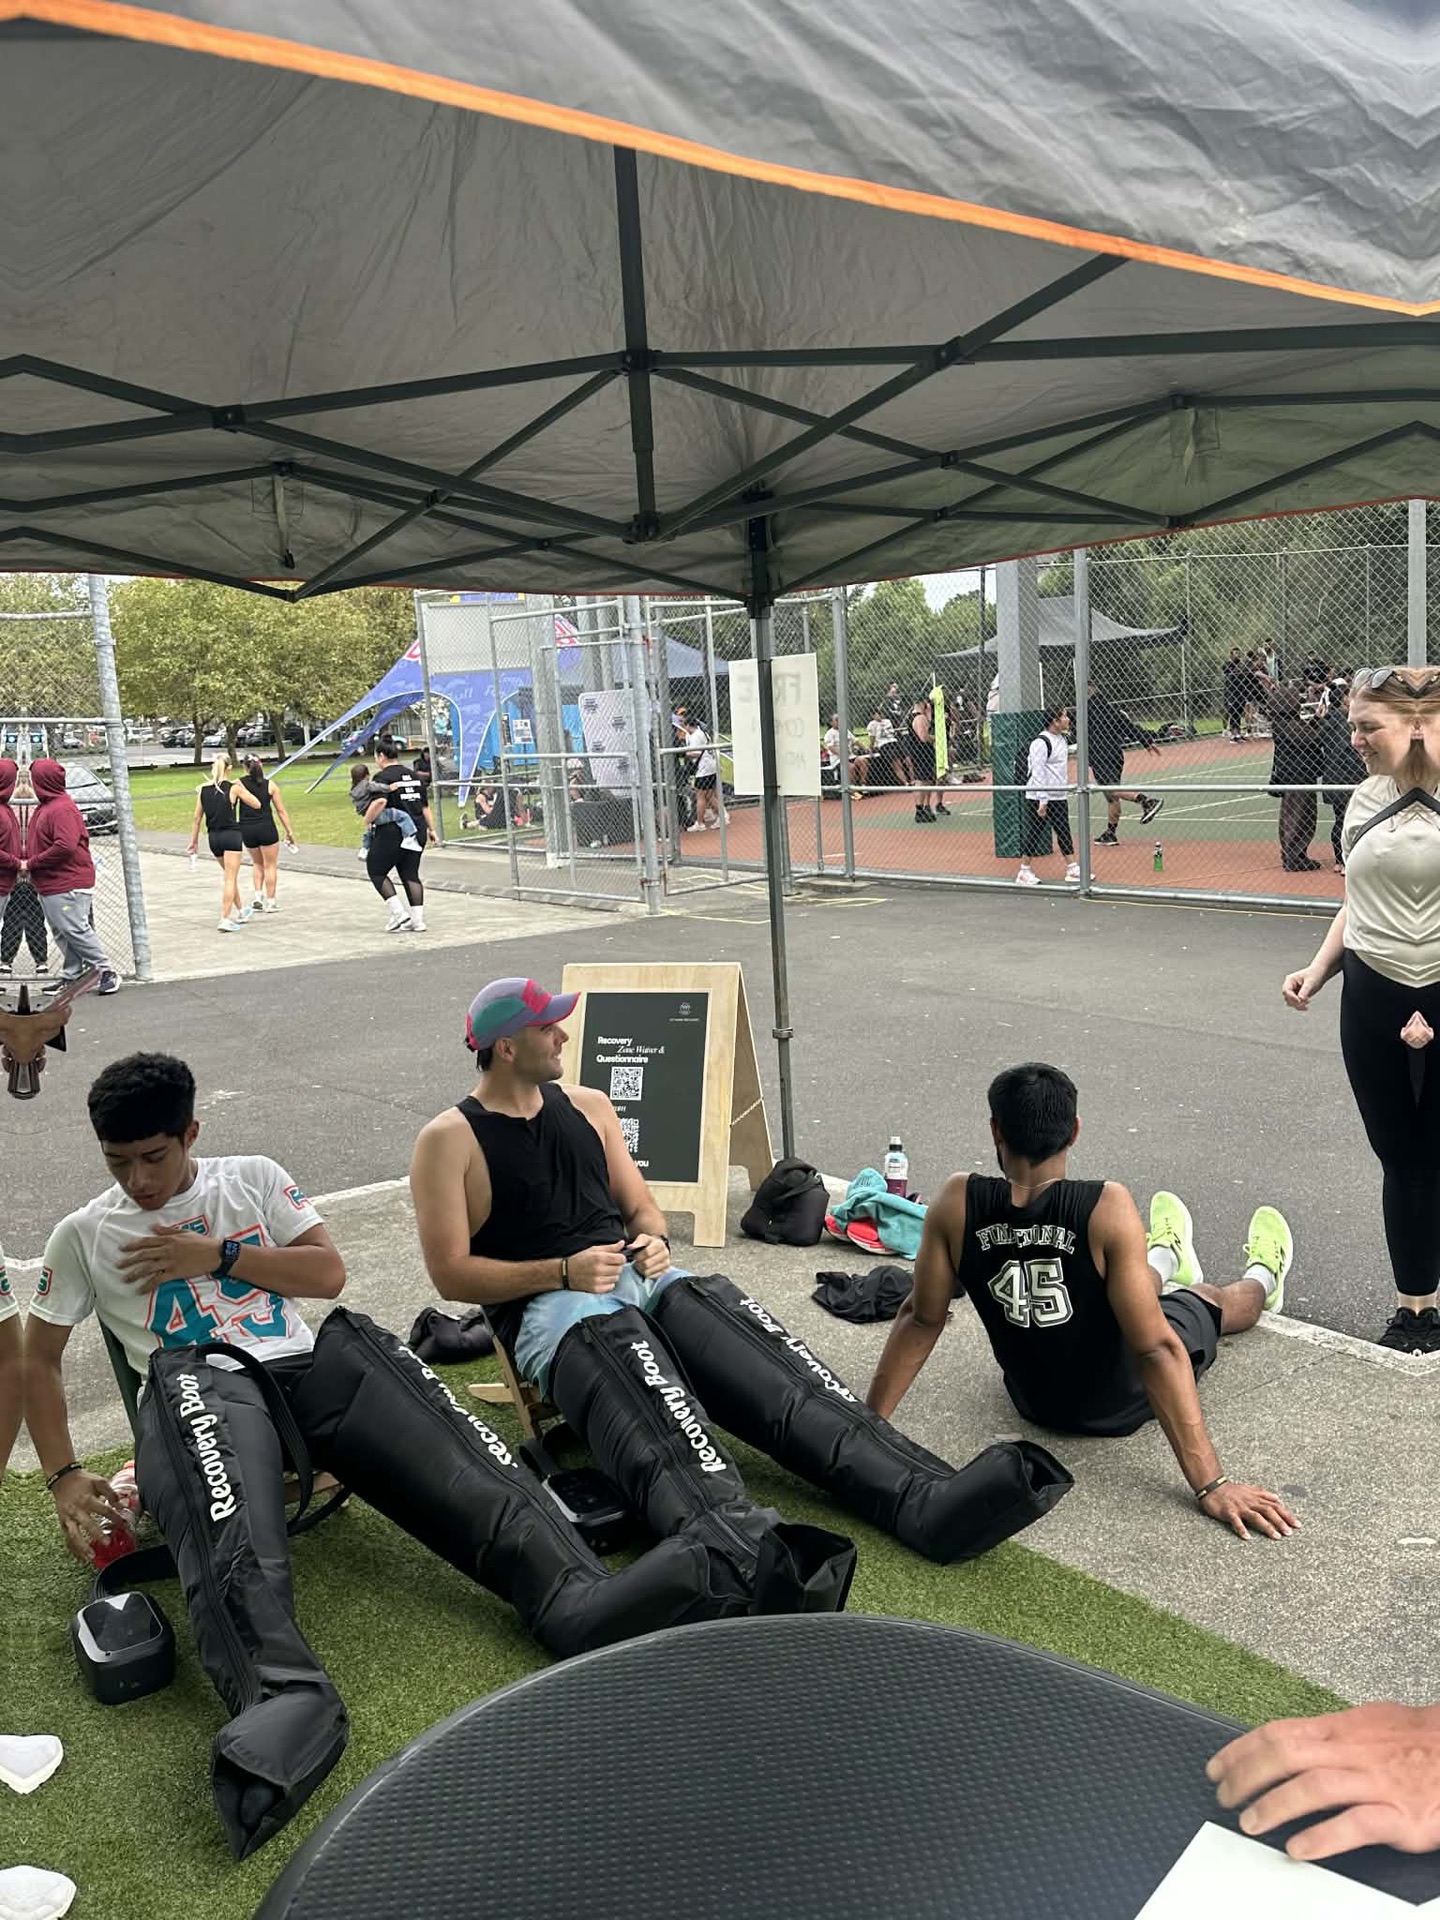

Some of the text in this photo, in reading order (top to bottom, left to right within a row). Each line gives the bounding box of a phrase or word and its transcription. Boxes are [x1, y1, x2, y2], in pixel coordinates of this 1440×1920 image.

[596, 1054, 649, 1064] Questionnaire
[597, 1036, 633, 1047] Recovery
[975, 1223, 1077, 1255] FUNTIONAL
[987, 1257, 1074, 1329] 45
[739, 1297, 785, 1334] Boot
[630, 1340, 727, 1473] Recovery Boot
[176, 1373, 238, 1522] Recovery Boot
